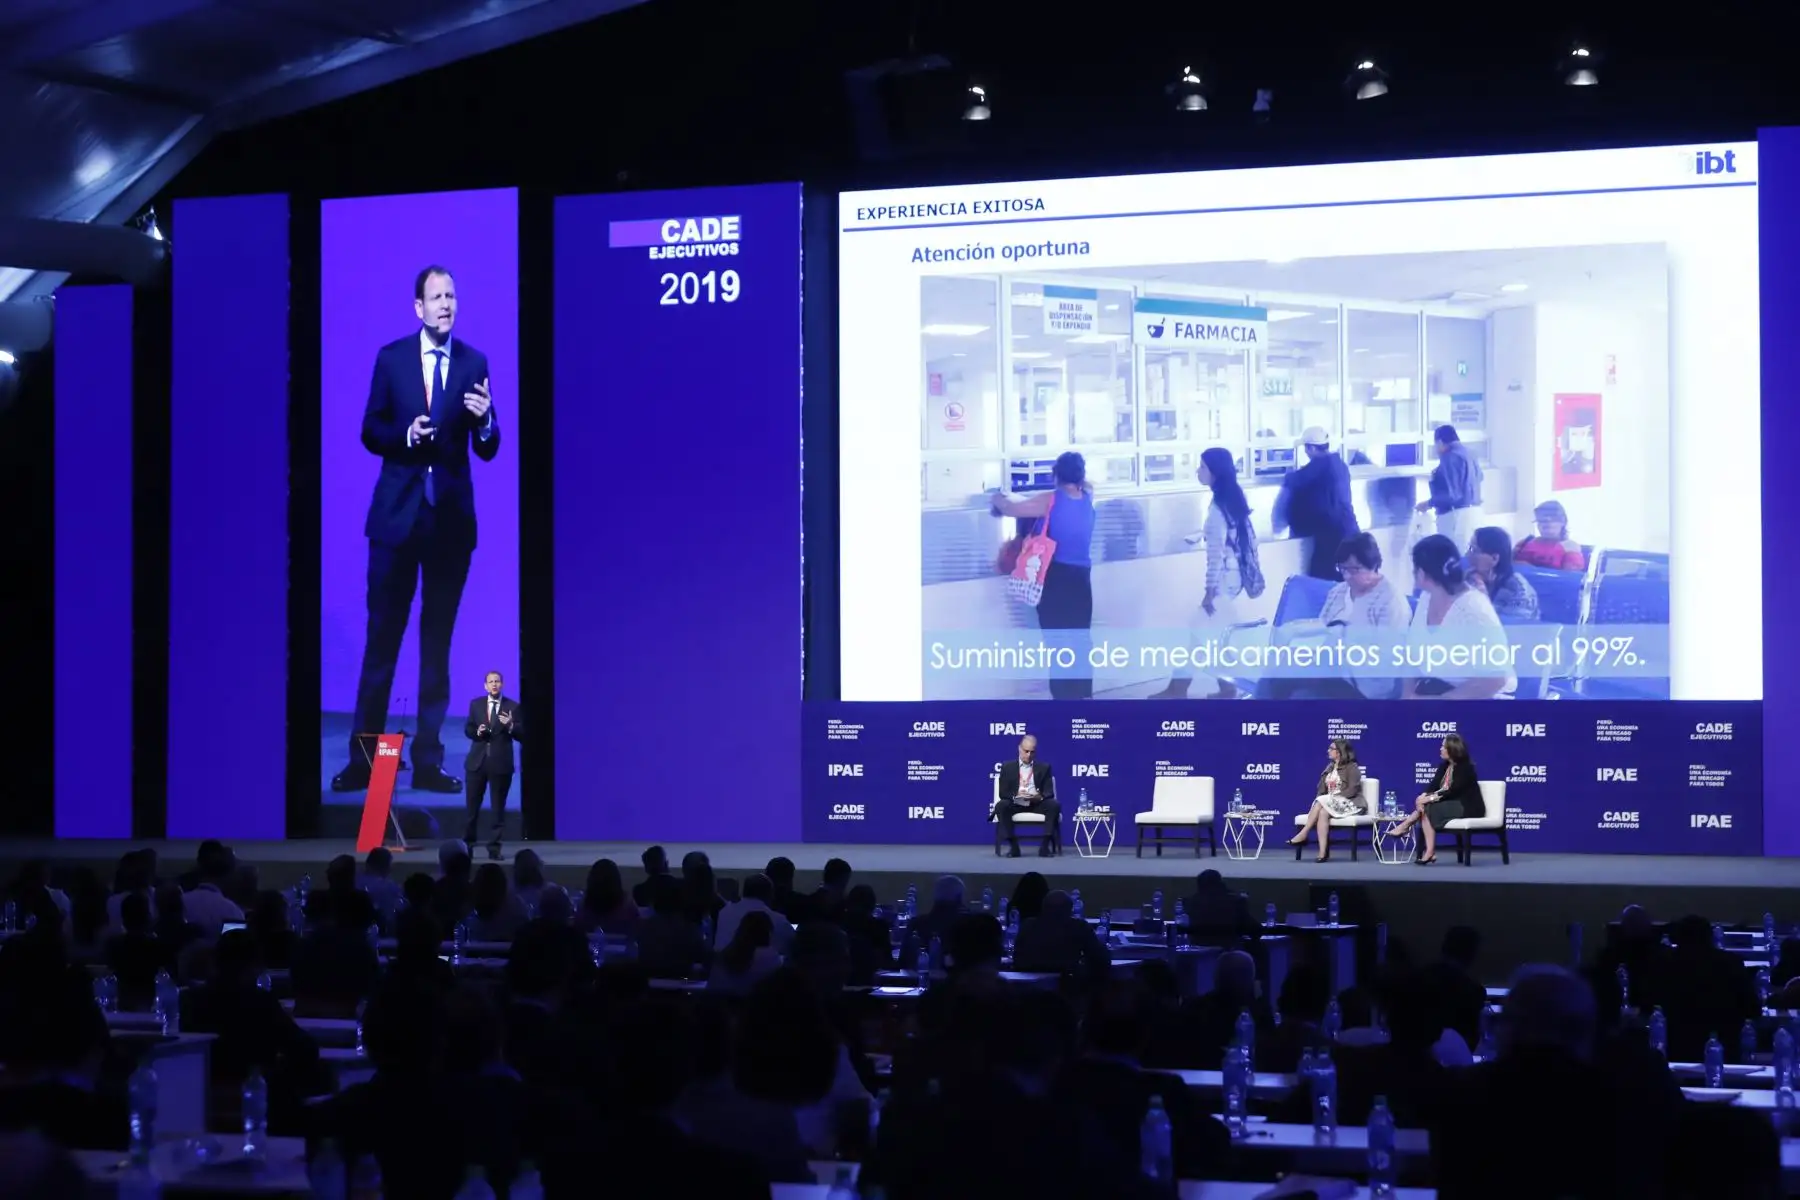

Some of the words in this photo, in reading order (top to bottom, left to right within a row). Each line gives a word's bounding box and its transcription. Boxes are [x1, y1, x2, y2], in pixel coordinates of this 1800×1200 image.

[1696, 150, 1736, 174] ibt
[857, 202, 967, 221] EXPERIENCIA
[973, 198, 1045, 214] EXITOSA
[661, 216, 740, 243] CADE
[649, 243, 739, 259] EJECUTIVOS
[912, 242, 996, 264] Atención
[1002, 239, 1091, 264] oportuna
[660, 269, 740, 305] 2019
[1174, 322, 1257, 342] FARMACIA
[931, 641, 1076, 668] Suministro
[1088, 640, 1130, 668] de
[1140, 638, 1380, 668] medicamentos
[1392, 638, 1521, 672] superior
[1532, 638, 1560, 666] al
[1571, 636, 1646, 666] 99%.
[913, 722, 945, 731] CADE
[990, 722, 1026, 735] IPAE
[1162, 721, 1195, 730] CADE
[1242, 723, 1280, 735] IPAE
[1422, 722, 1456, 731] CADE
[1506, 724, 1546, 736] IPAE
[1696, 723, 1732, 733] CADE
[828, 764, 863, 776] IPAE
[1072, 764, 1109, 776] IPAE
[1246, 764, 1280, 773] CADE
[1511, 766, 1546, 776] CADE
[1596, 768, 1637, 781] IPAE
[833, 804, 864, 813] CADE
[908, 806, 944, 818] IPAE
[1603, 812, 1639, 821] CADE
[1690, 814, 1732, 828] IPAE
